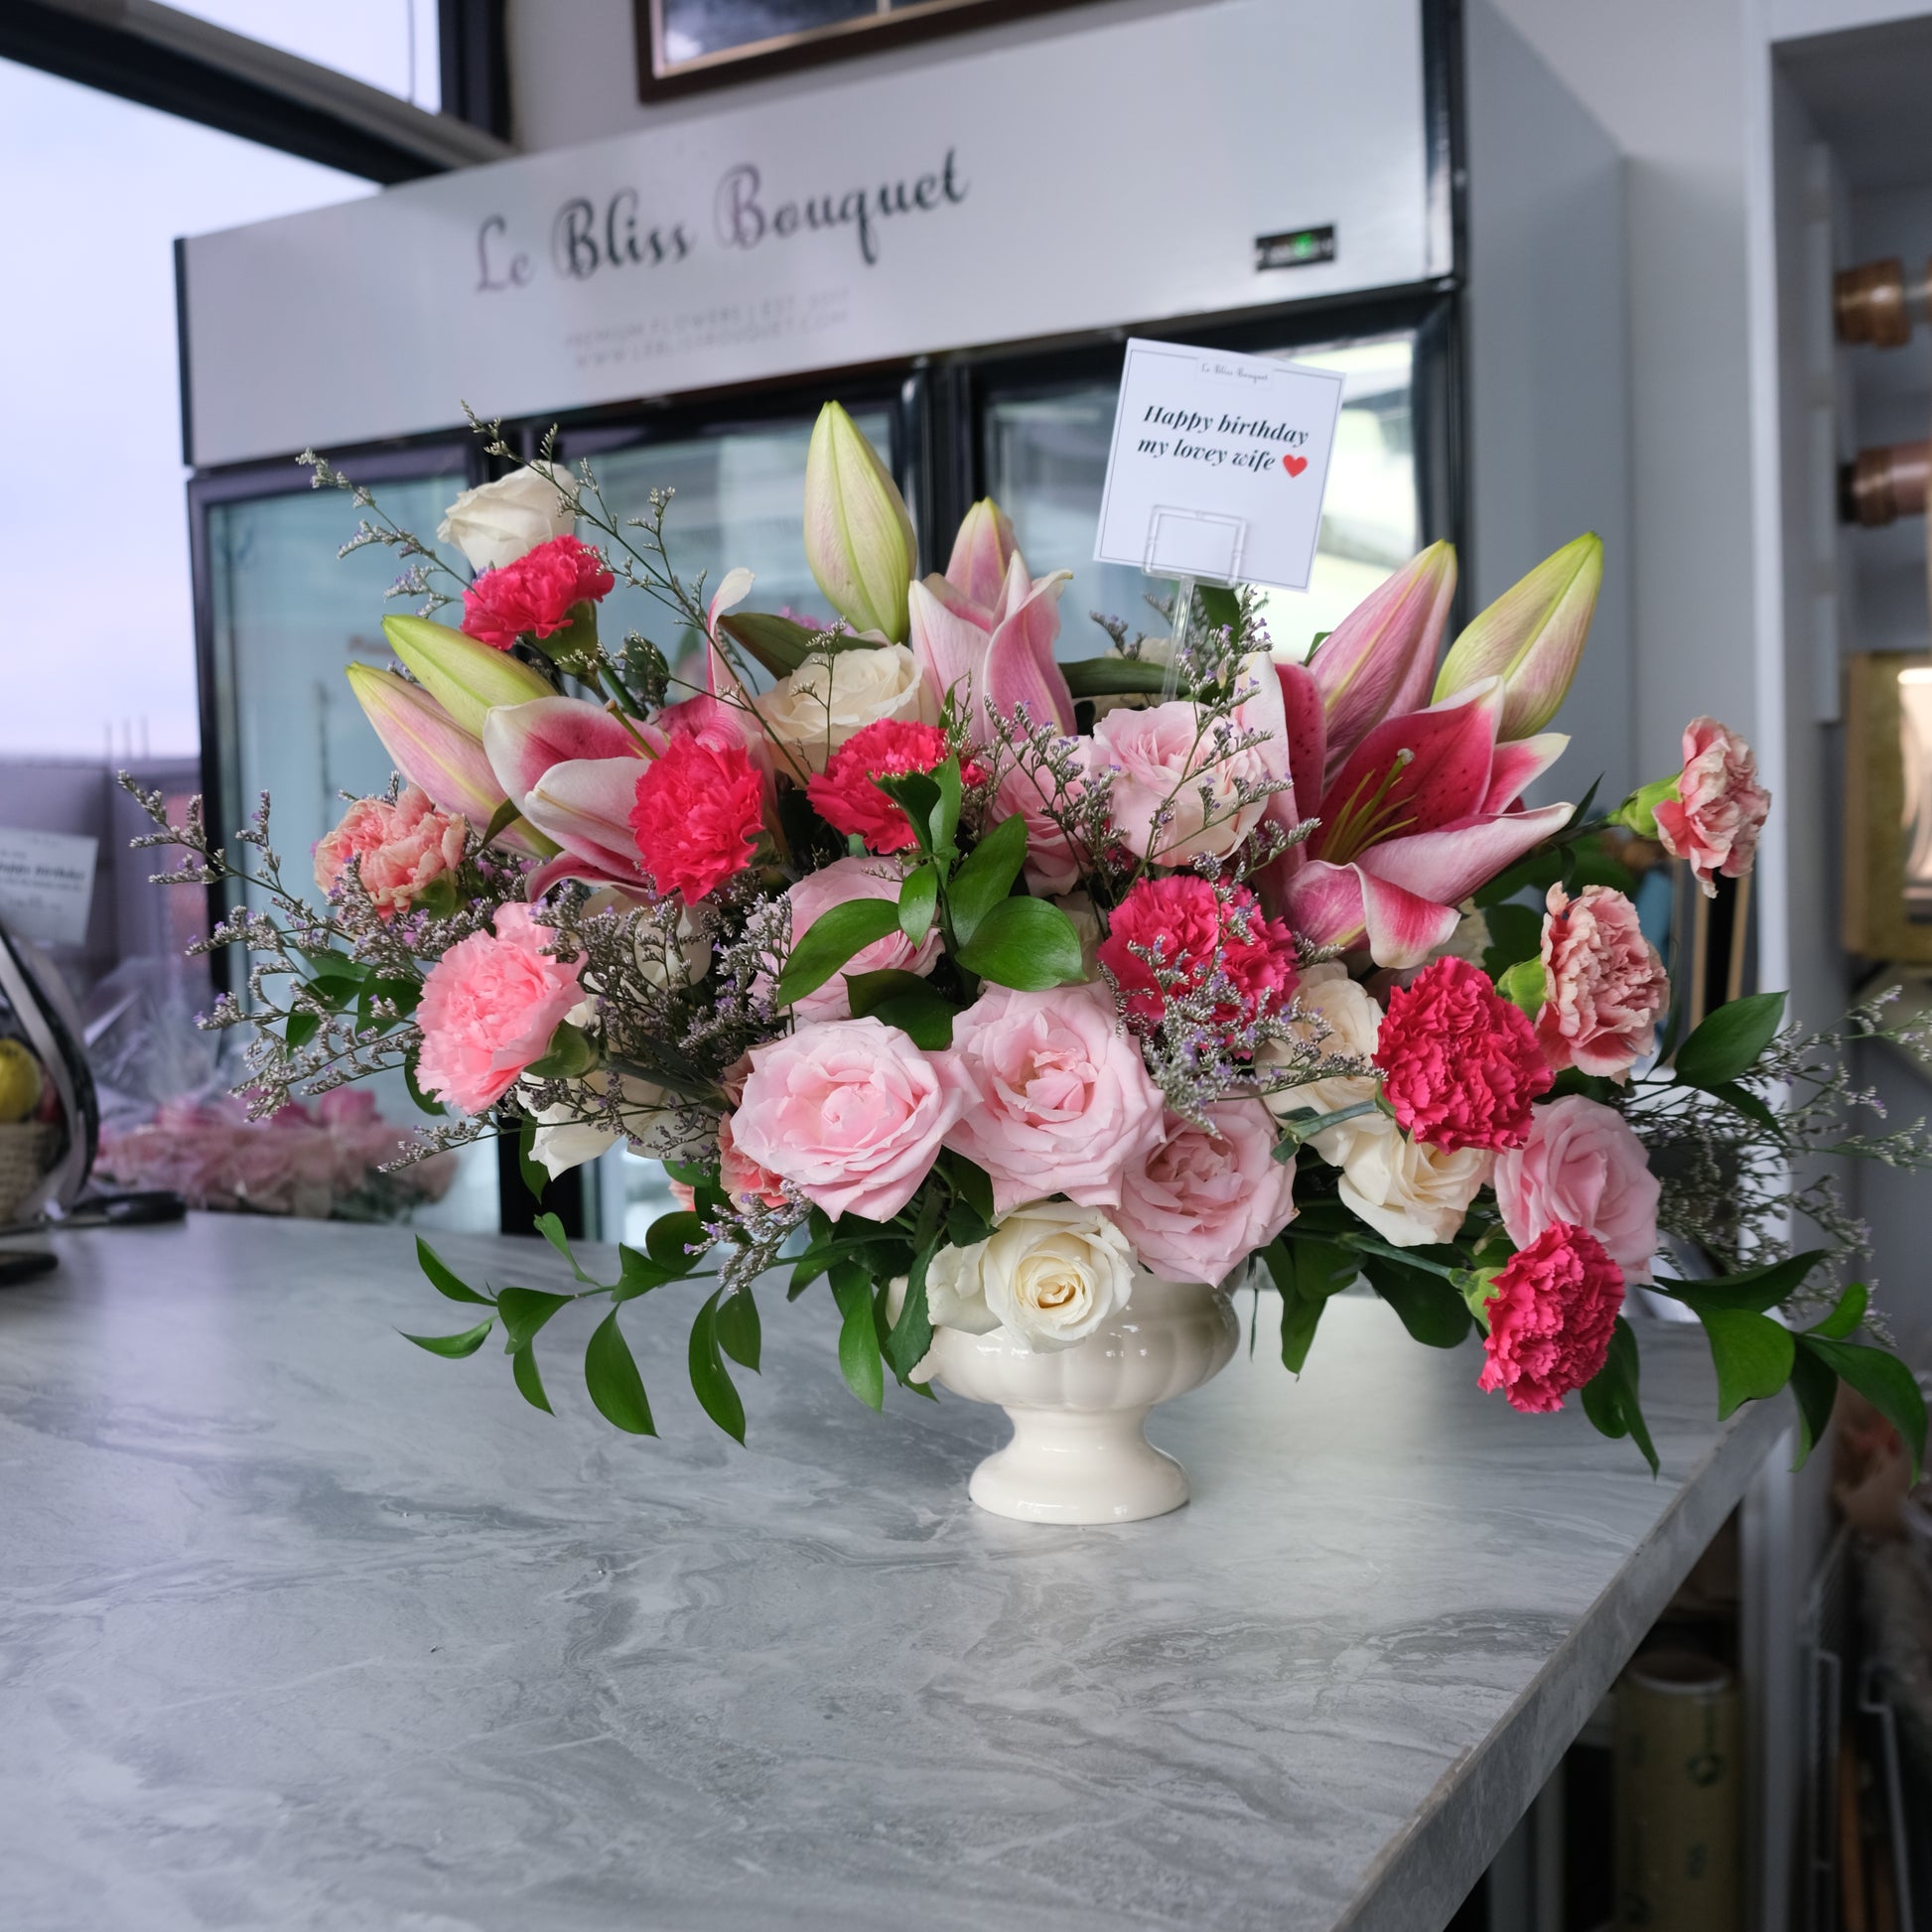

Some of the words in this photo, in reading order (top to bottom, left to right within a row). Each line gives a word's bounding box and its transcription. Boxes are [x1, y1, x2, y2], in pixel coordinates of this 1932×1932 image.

[475, 212, 535, 294] Le
[550, 186, 698, 281] Bliss
[712, 145, 971, 267] Bouquet
[1143, 405, 1214, 434] Happy
[1217, 413, 1310, 448] birthday
[1137, 438, 1170, 459] my
[1173, 439, 1228, 467] lovey
[1231, 449, 1277, 473] wife
